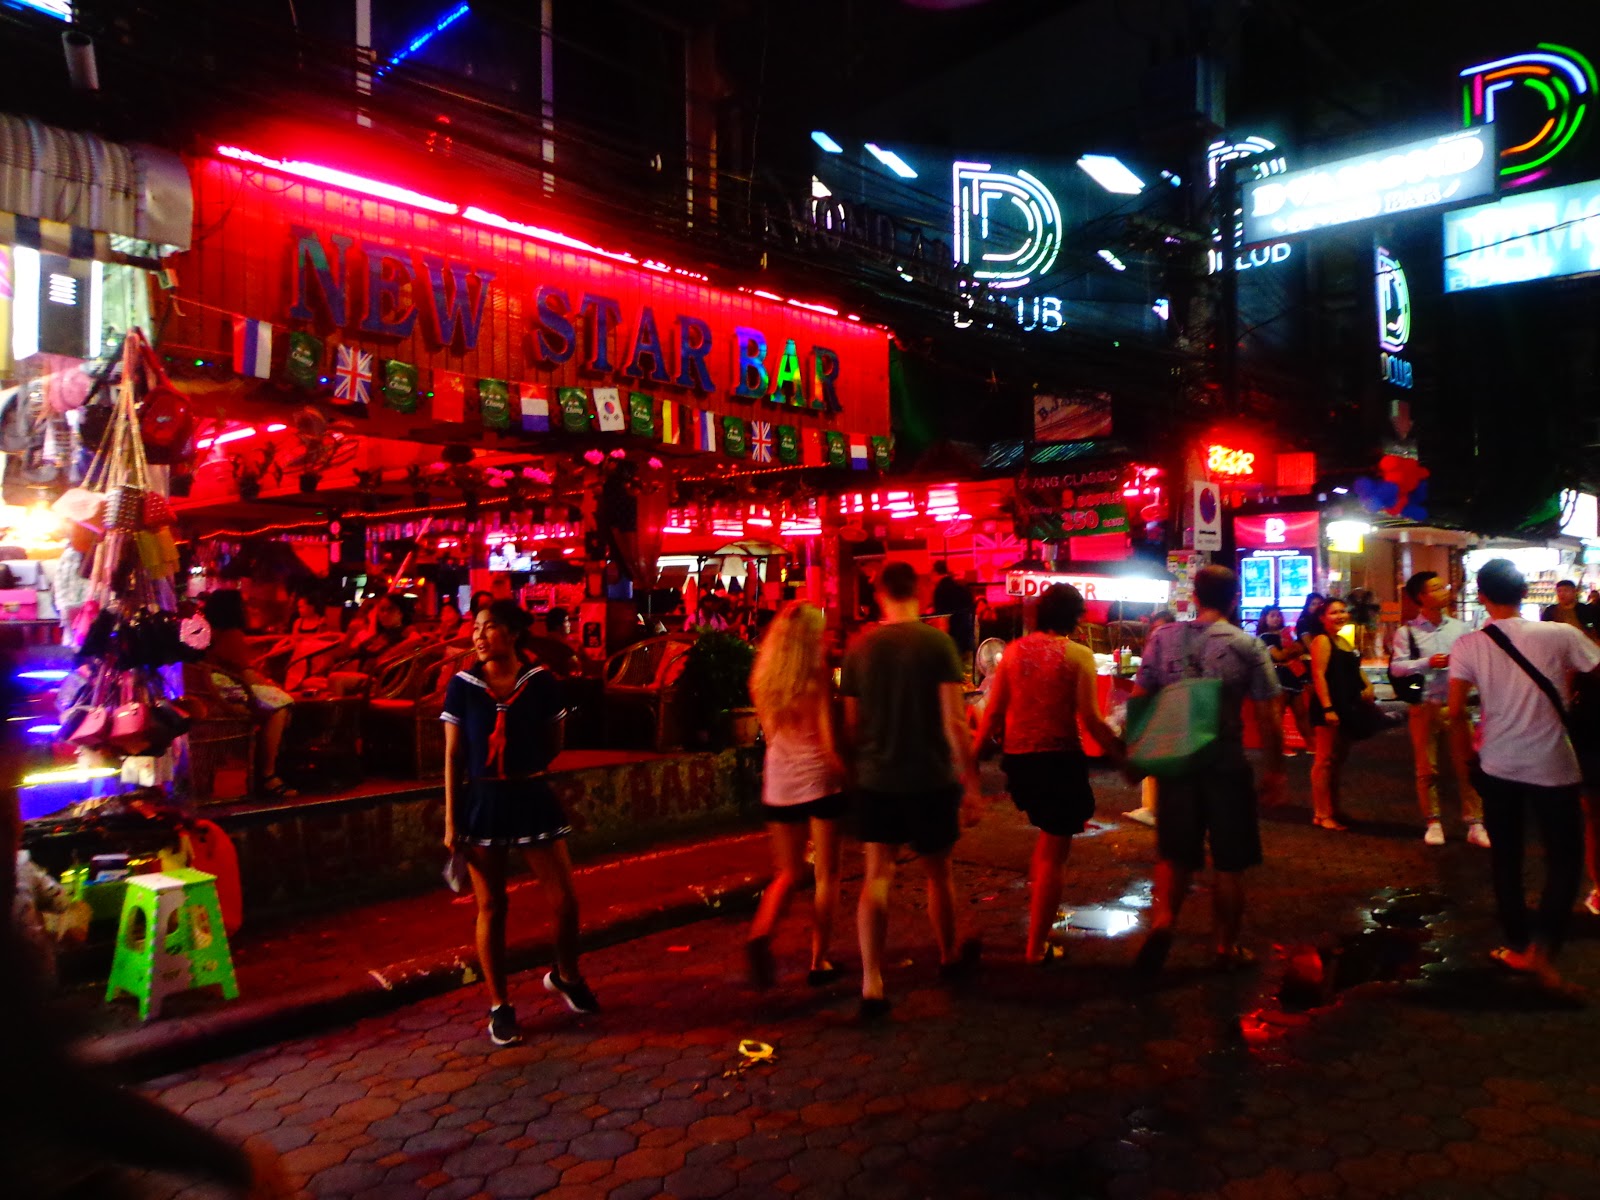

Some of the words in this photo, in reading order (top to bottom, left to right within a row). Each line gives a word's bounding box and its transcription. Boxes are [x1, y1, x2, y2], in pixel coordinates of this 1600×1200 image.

[289, 226, 497, 349] NEW
[532, 285, 716, 392] STAR
[732, 326, 843, 412] BAR
[1063, 469, 1118, 486] CLASSIC
[1061, 510, 1099, 532] 350
